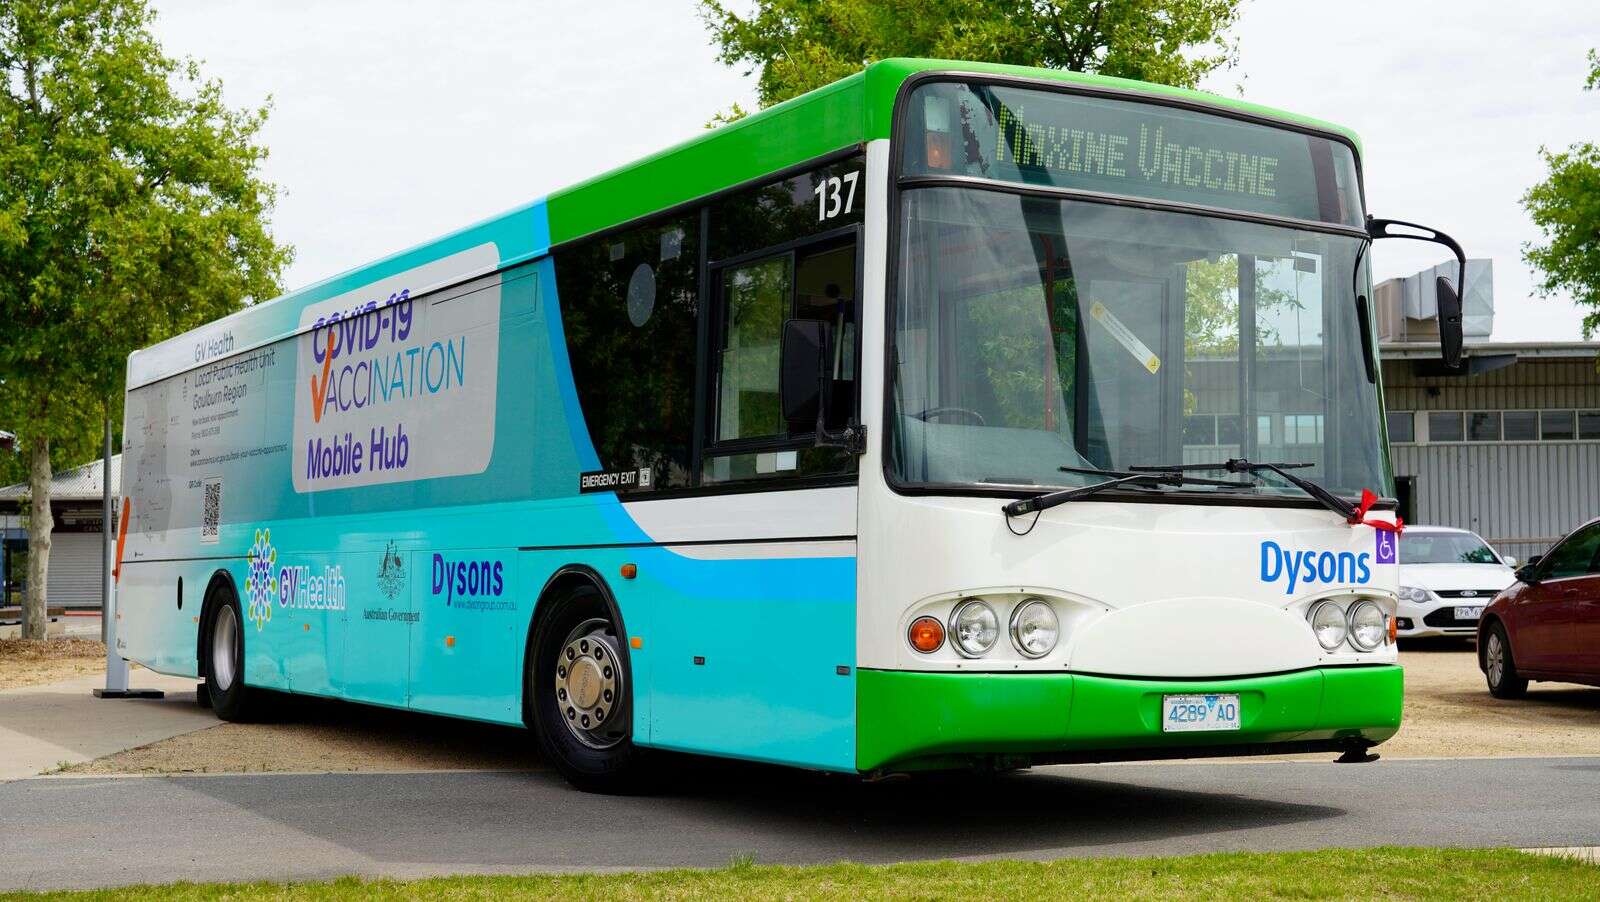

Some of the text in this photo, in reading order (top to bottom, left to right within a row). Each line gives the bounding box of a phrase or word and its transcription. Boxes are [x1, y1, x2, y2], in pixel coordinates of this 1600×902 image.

[814, 170, 860, 221] 137
[194, 331, 234, 361] GV Health
[312, 288, 413, 364] COVID-19
[194, 348, 276, 388] Local Public Health Unit
[311, 331, 465, 424] VACCINATION
[193, 389, 222, 410] Goulburn
[223, 382, 247, 404] Region
[306, 422, 409, 480] Mobile Hub
[582, 470, 637, 488] EMERGENCY EXIT
[432, 553, 504, 607] Dysons
[1260, 540, 1371, 595] Dysons
[362, 607, 421, 623] Australian Government
[1168, 704, 1207, 723] 4289
